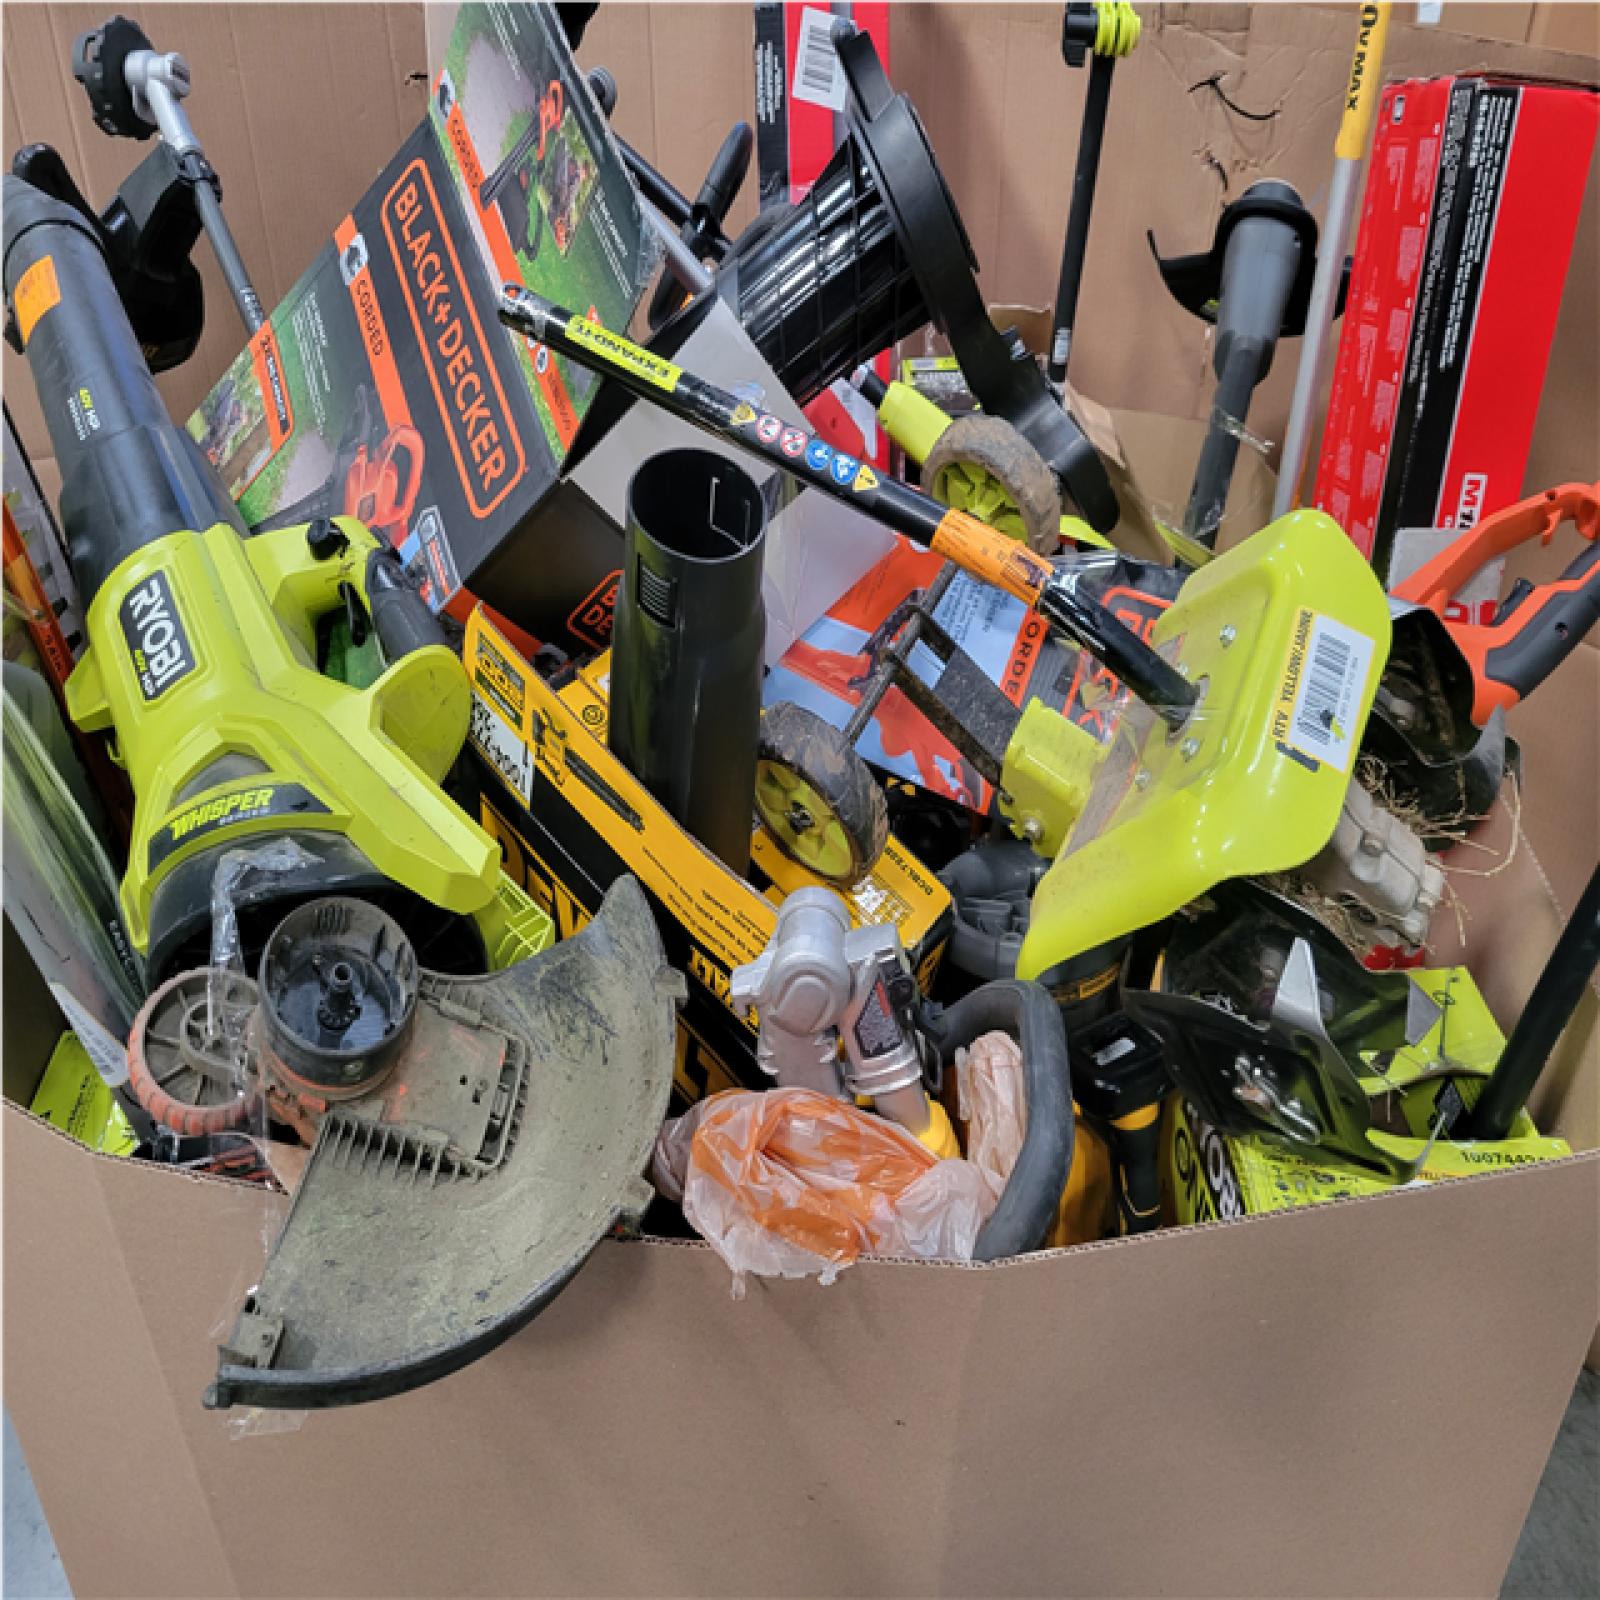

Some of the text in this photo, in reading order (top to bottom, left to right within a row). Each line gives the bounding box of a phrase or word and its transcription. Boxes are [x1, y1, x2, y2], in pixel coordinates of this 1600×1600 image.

[1347, 52, 1366, 111] MAX
[354, 278, 384, 356] CORDED
[394, 182, 506, 491] BLACK+DECKER
[129, 579, 186, 688] RYOBI
[170, 788, 275, 841] WHISPER
